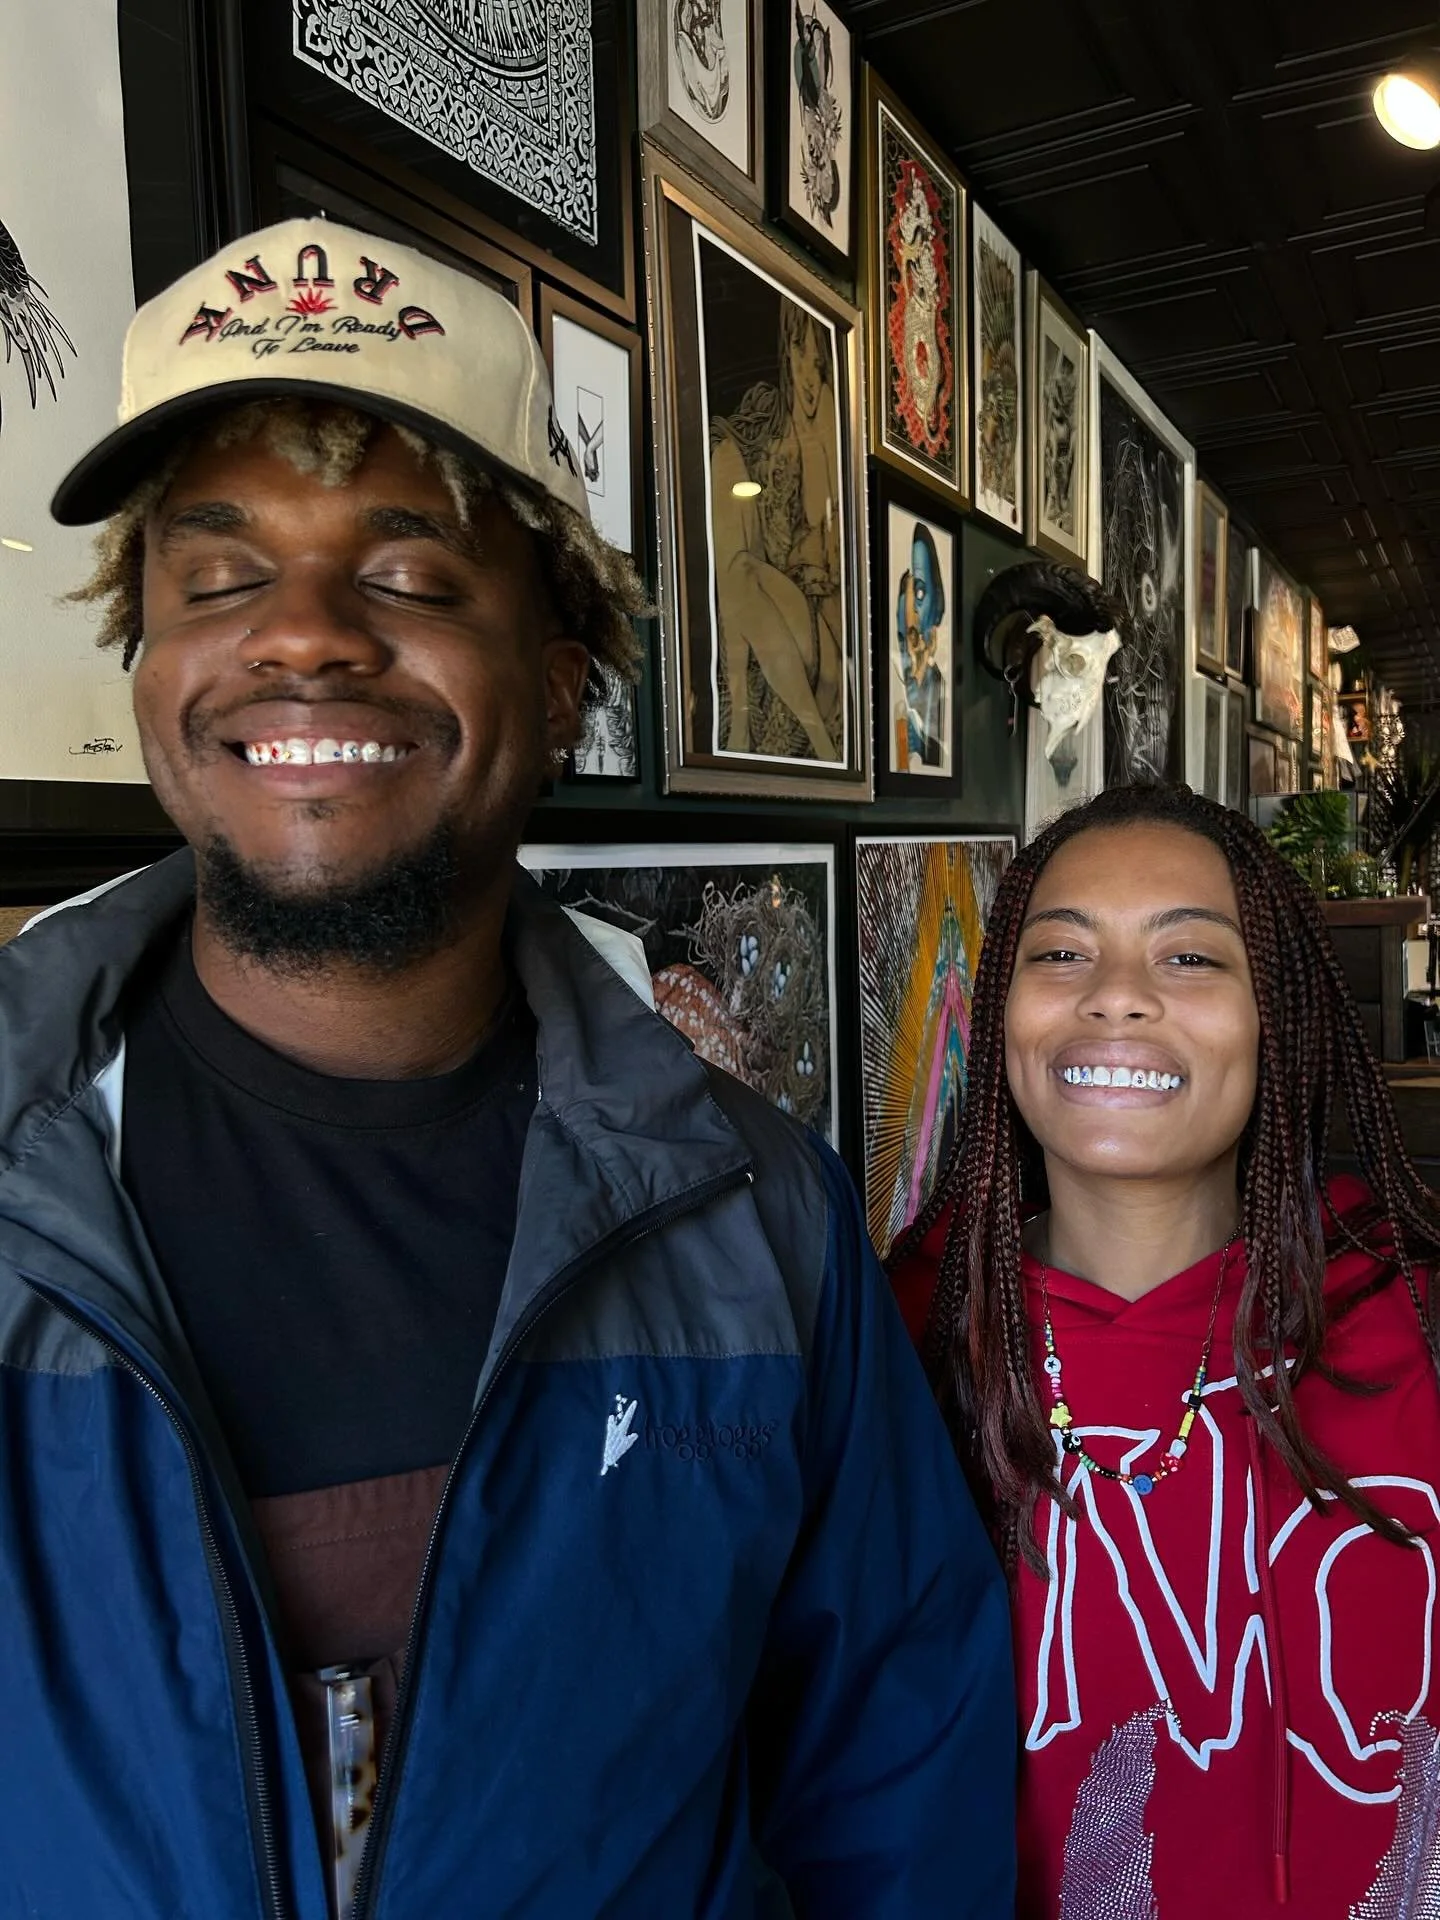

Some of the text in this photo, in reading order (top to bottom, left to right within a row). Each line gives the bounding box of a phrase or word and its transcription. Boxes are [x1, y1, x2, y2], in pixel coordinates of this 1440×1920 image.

[179, 244, 446, 346] DRUNK
[218, 315, 402, 343] And I'm Ready
[251, 337, 361, 360] To Leave
